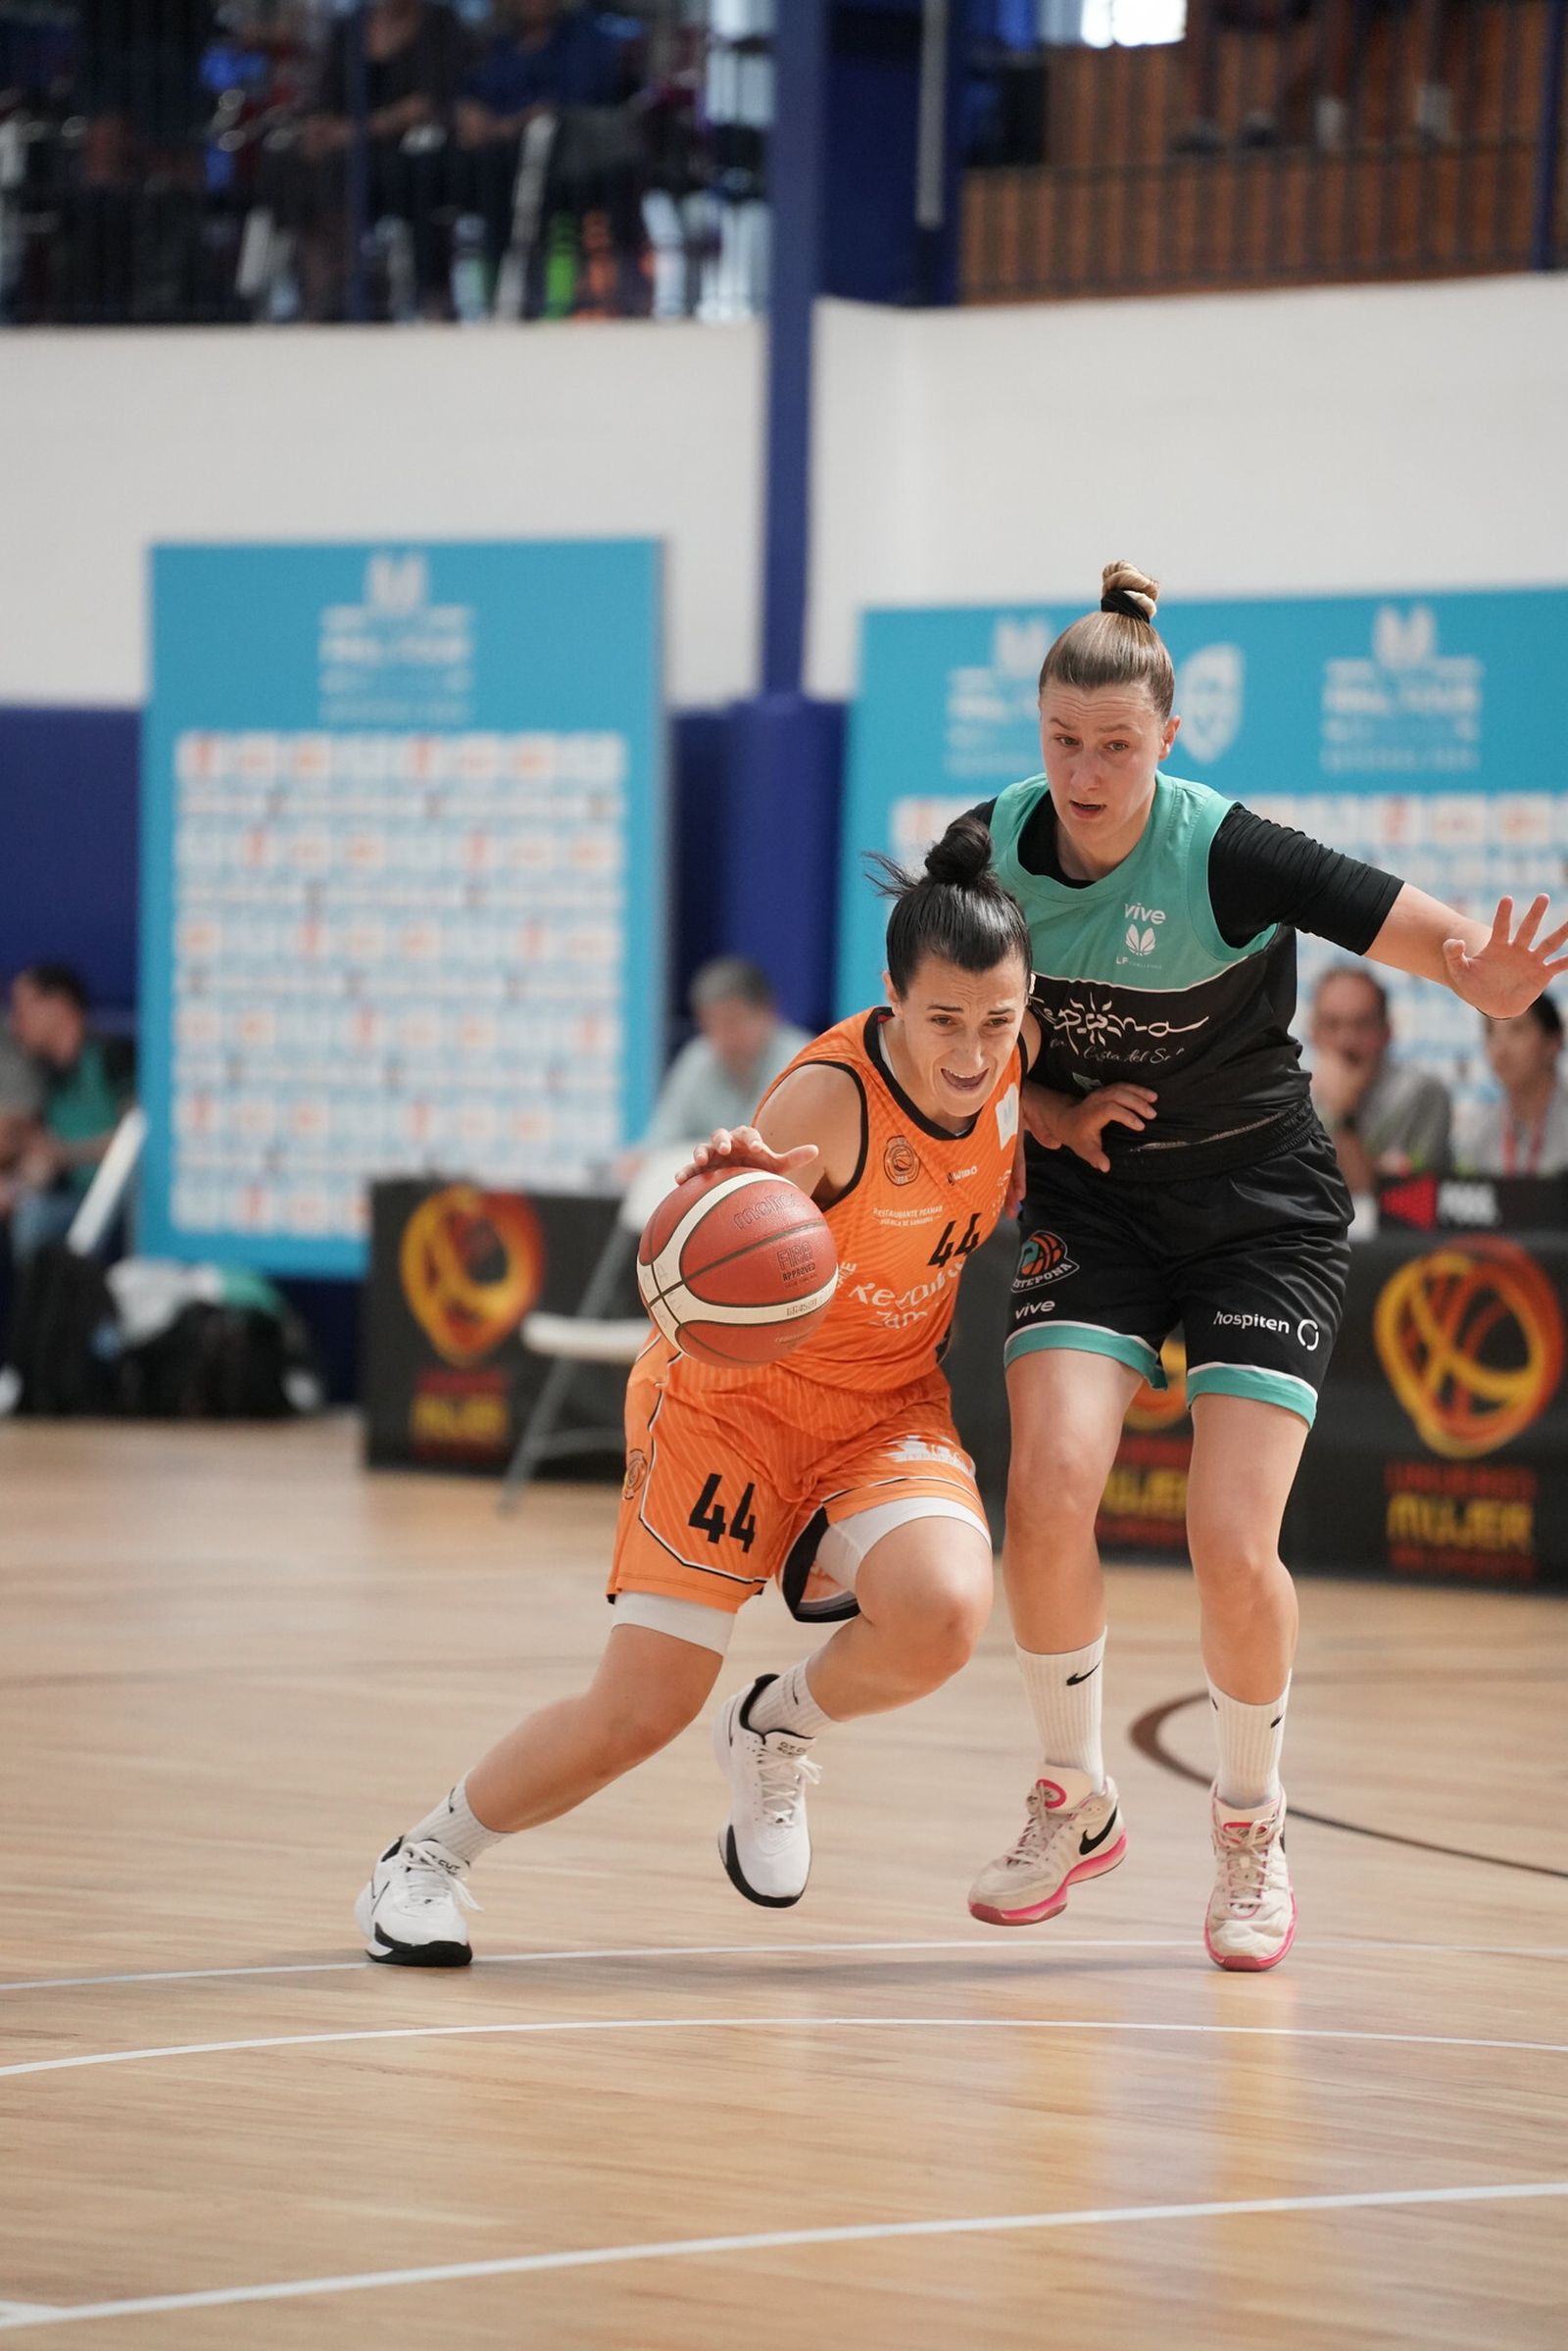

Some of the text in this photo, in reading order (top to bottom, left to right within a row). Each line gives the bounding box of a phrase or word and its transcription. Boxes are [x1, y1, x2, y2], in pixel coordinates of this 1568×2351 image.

[1125, 903, 1166, 924] vive
[927, 1212, 982, 1268] 44
[777, 1243, 812, 1271] FIBA
[1015, 1300, 1055, 1319] vive
[1213, 1310, 1290, 1334] hospiten
[688, 1473, 756, 1553] 44
[1386, 1492, 1535, 1553] MUJER
